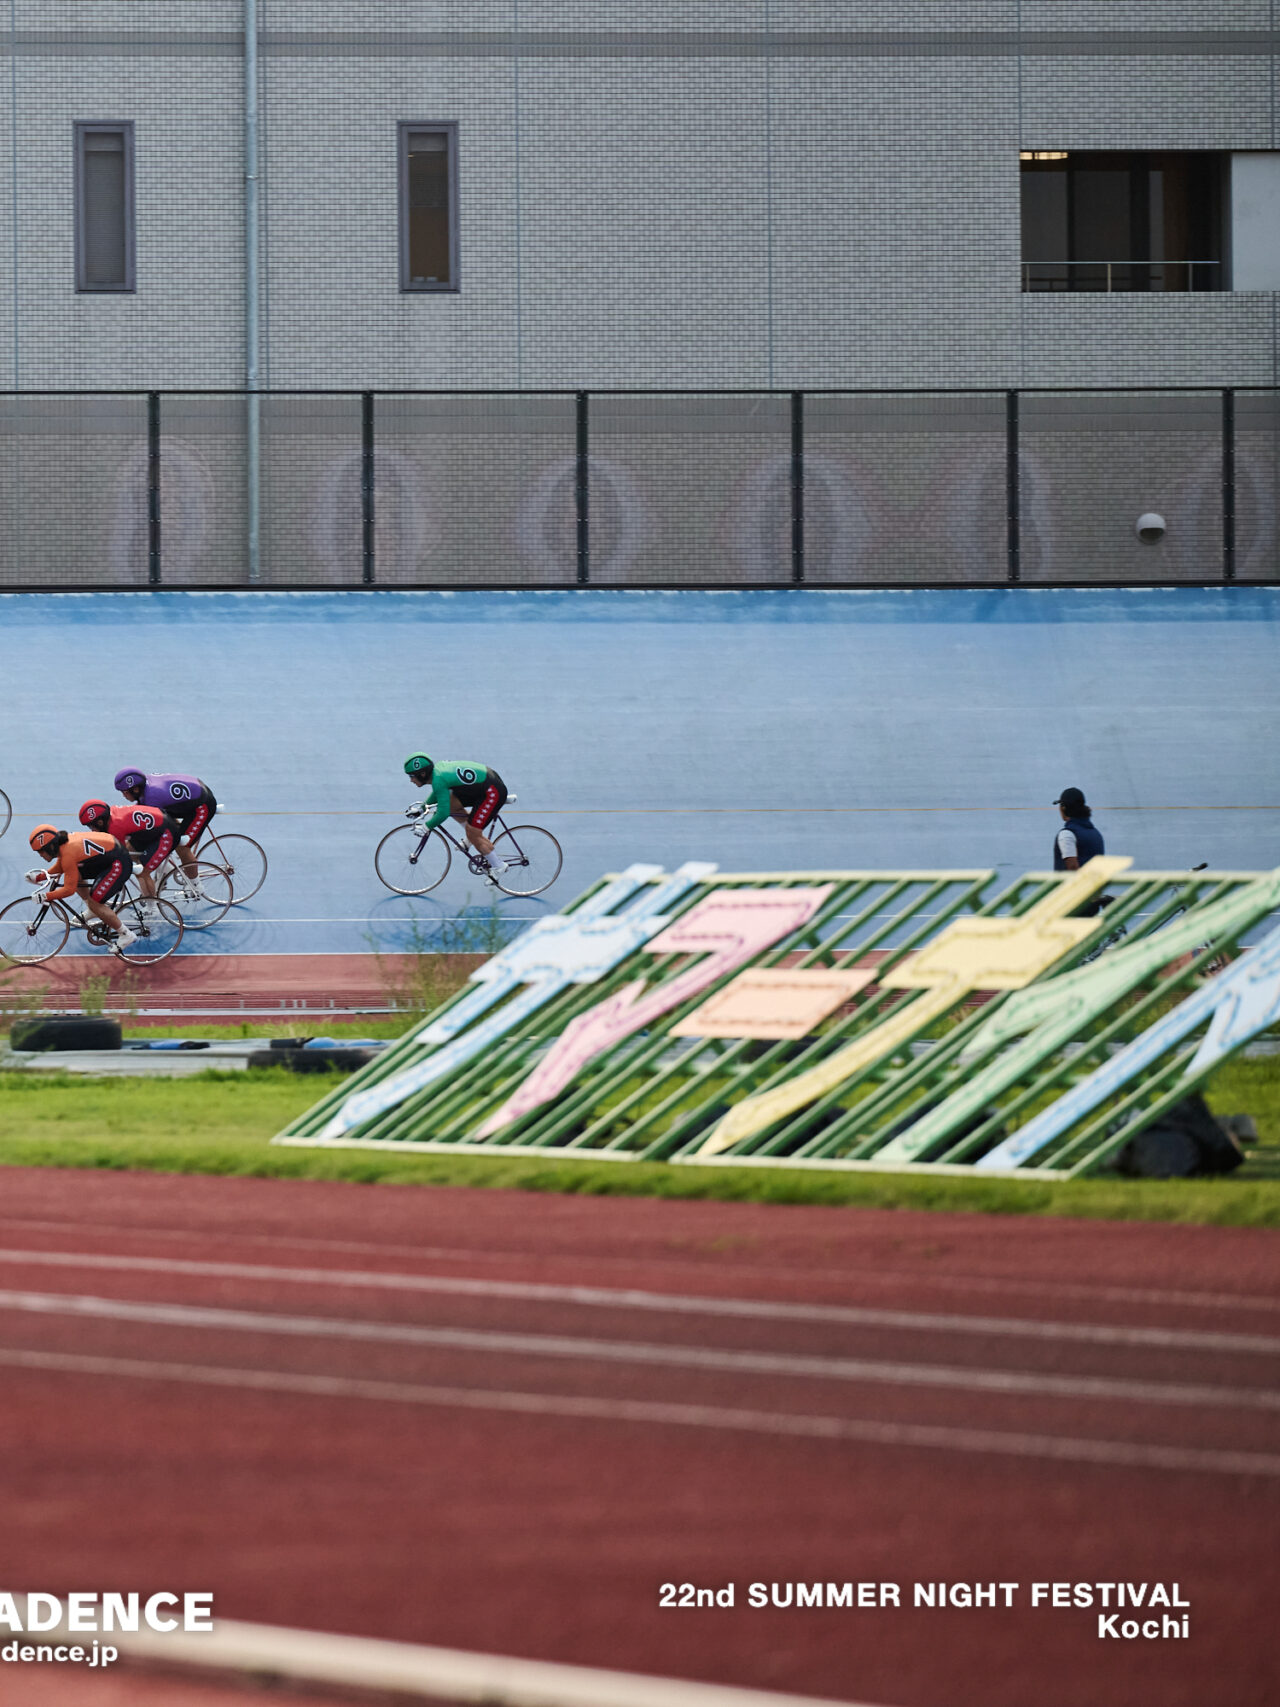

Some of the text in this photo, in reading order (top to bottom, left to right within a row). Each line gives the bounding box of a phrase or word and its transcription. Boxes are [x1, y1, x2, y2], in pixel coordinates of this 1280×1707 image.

[412, 757, 421, 770] 6
[125, 775, 134, 788] 9
[456, 767, 477, 785] 6
[169, 782, 192, 800] 9
[86, 807, 96, 820] 3
[132, 810, 155, 831] 3
[82, 838, 105, 856] 7
